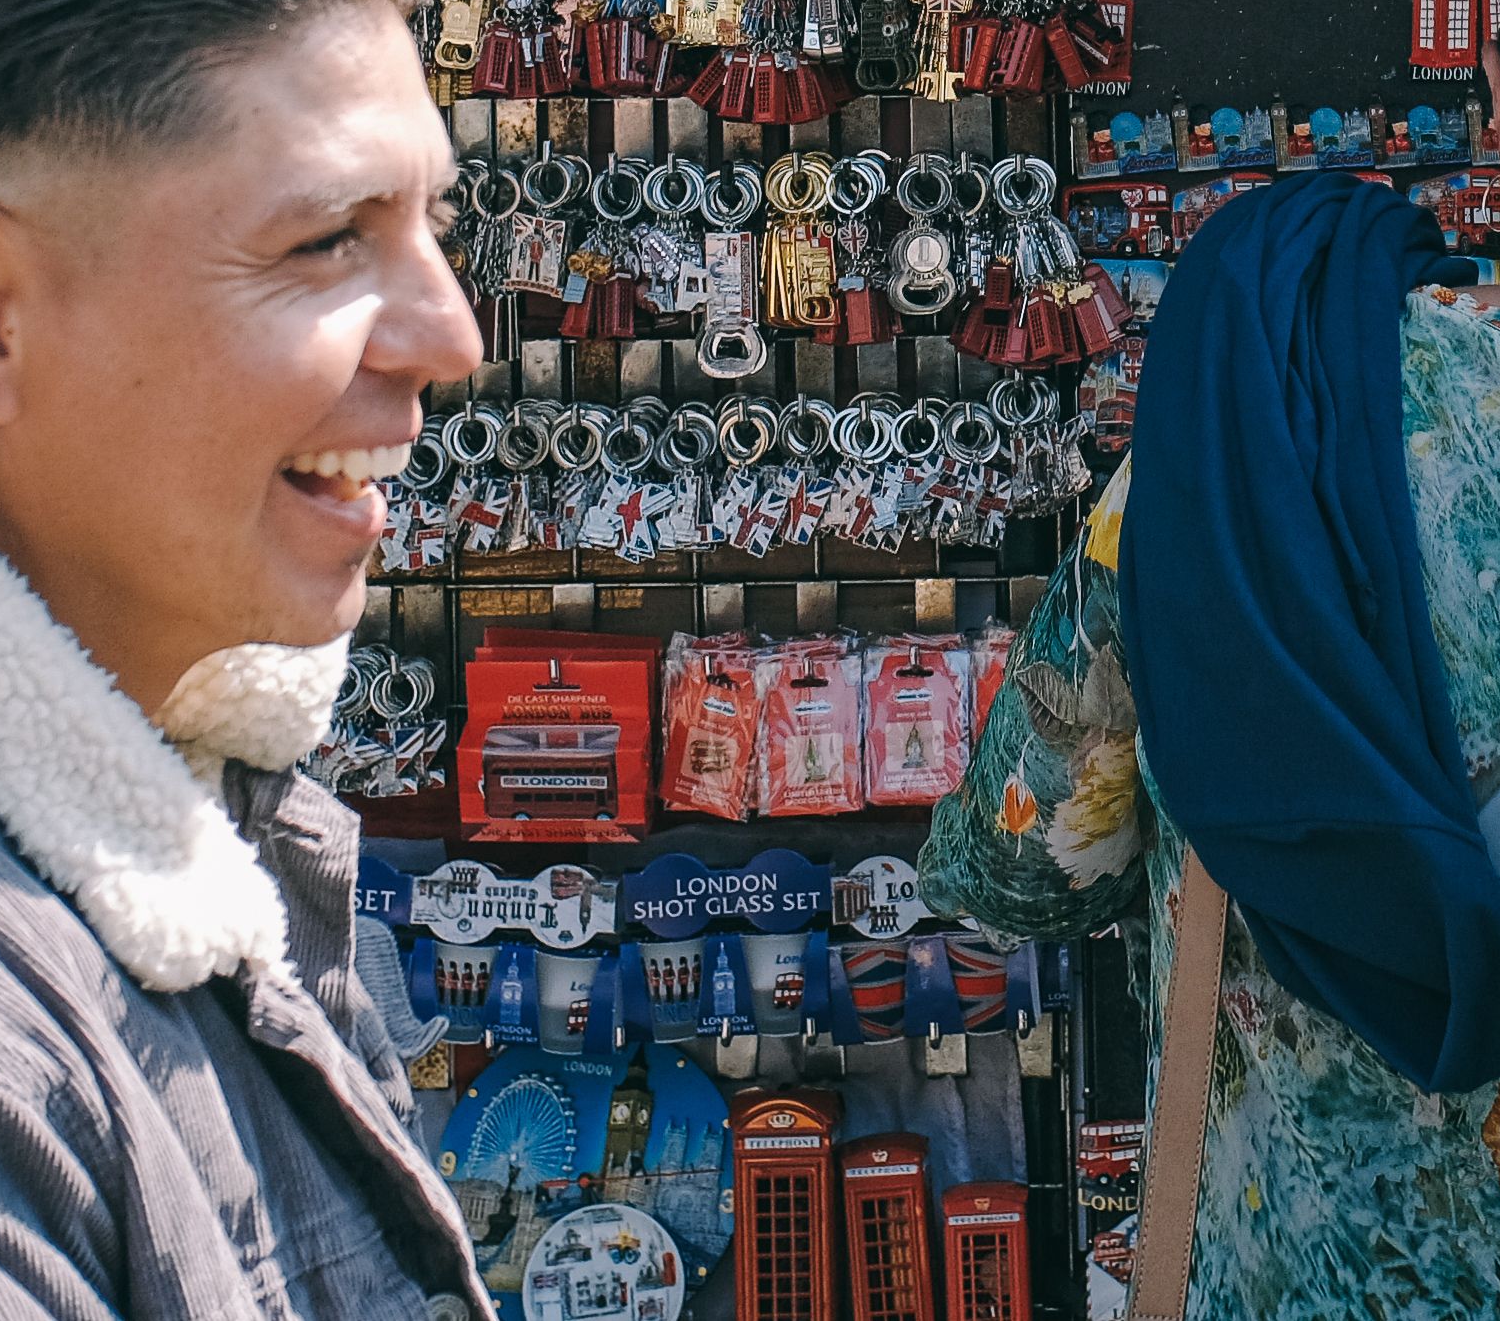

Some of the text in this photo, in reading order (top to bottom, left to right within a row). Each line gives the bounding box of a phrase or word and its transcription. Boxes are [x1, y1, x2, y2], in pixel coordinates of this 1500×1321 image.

[1412, 67, 1473, 81] LONDON
[525, 694, 551, 704] CAST
[551, 694, 607, 704] SHARPENER
[520, 776, 588, 787] LONDON
[675, 874, 778, 897] LONDON
[633, 891, 820, 920] SHOT GLASS SET
[563, 1060, 613, 1077] LONDON
[749, 1137, 816, 1148] TELEPHONE
